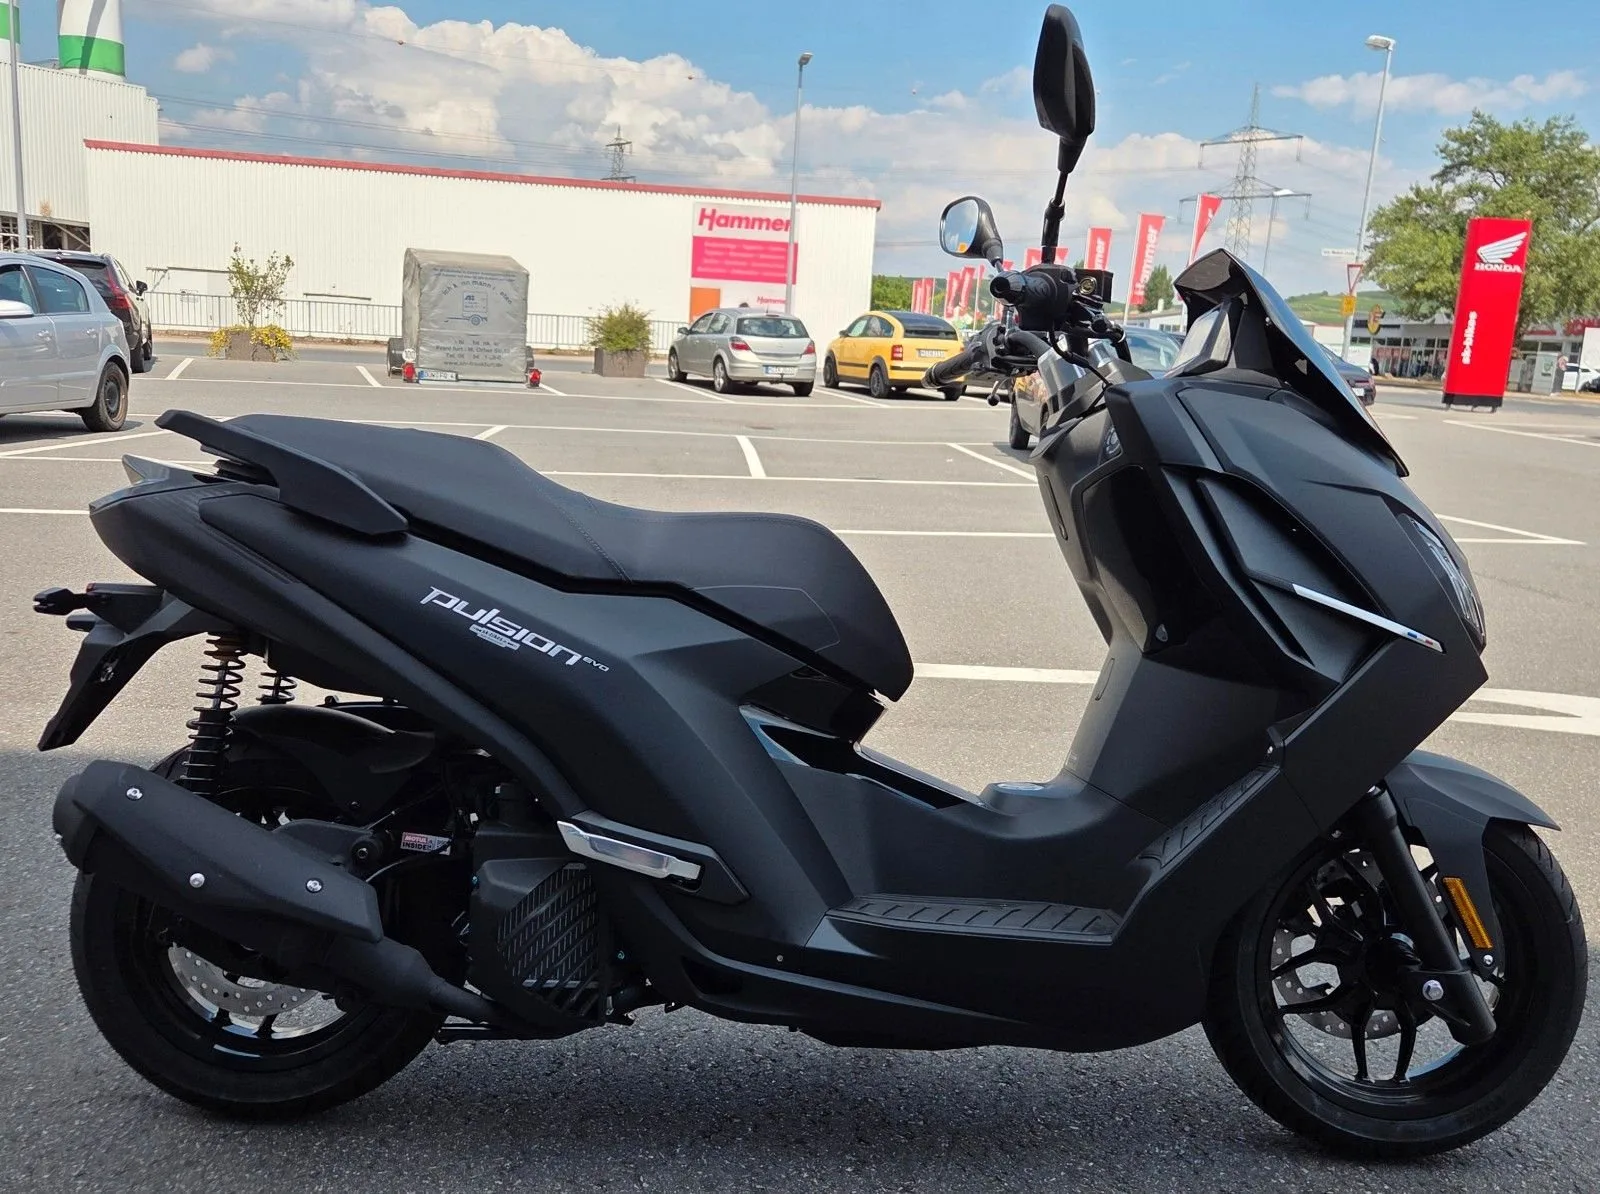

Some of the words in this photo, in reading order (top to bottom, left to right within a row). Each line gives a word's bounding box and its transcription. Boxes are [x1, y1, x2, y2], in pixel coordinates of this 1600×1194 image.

[698, 208, 792, 232] Hammer
[1135, 225, 1159, 296] Hammer
[1473, 262, 1523, 274] HONDA
[404, 835, 428, 844] MOTUL
